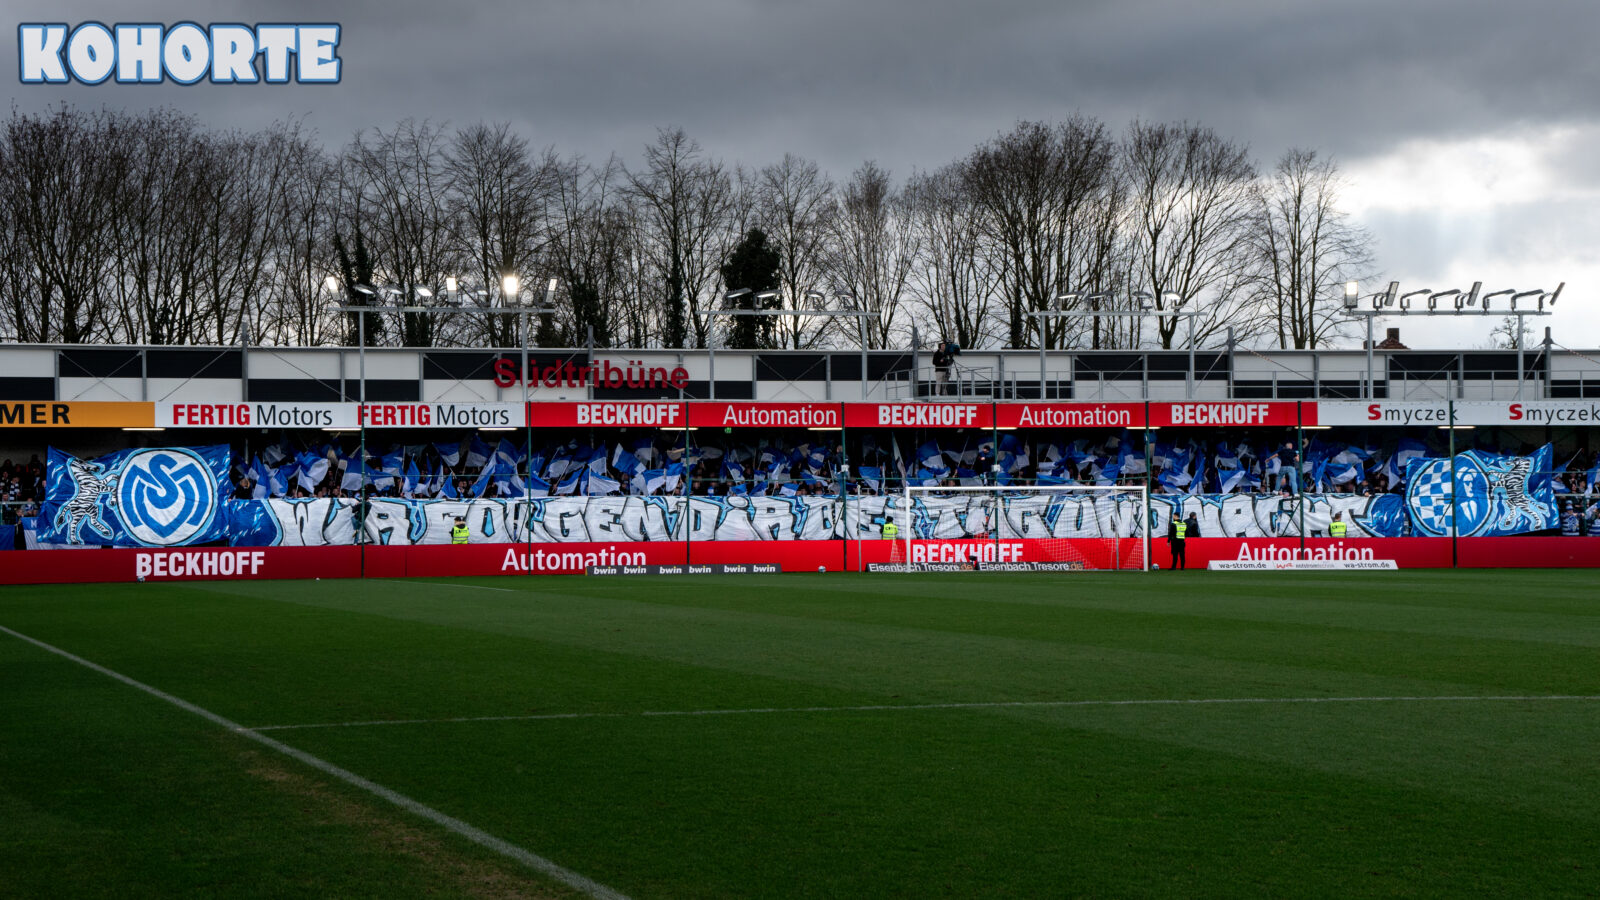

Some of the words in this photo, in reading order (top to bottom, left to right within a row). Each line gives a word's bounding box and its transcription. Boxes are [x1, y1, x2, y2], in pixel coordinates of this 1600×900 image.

[493, 358, 689, 389] Südtribüne
[173, 404, 250, 425] FERTIG
[257, 404, 333, 426] Motors
[357, 404, 430, 425] FERTIG
[437, 404, 509, 426] Motors
[577, 404, 680, 424] BECKHOFF
[723, 404, 838, 425] Automation
[878, 405, 978, 425] BECKHOFF
[1019, 405, 1131, 426] Automation
[1171, 404, 1269, 424] BECKHOFF
[1367, 404, 1459, 424] Smyczek
[1509, 404, 1600, 424] Smyczek
[501, 546, 647, 571] Automation
[912, 542, 1024, 563] BECKHOFF
[1236, 541, 1374, 561] Automation
[136, 551, 265, 577] BECKHOFF
[593, 566, 616, 576] bwin
[623, 566, 647, 576] bwin
[659, 565, 682, 575] bwin
[688, 565, 712, 575] bwin
[723, 563, 747, 574] bwin
[753, 563, 776, 574] bwin
[868, 562, 920, 573] Eisenbach
[922, 562, 974, 572] Tresore.de
[979, 561, 1031, 572] Eisenbach
[1032, 561, 1084, 571] Tresore.de
[1218, 561, 1267, 570] wa-strom.de
[1343, 560, 1390, 570] wa-strom.de
